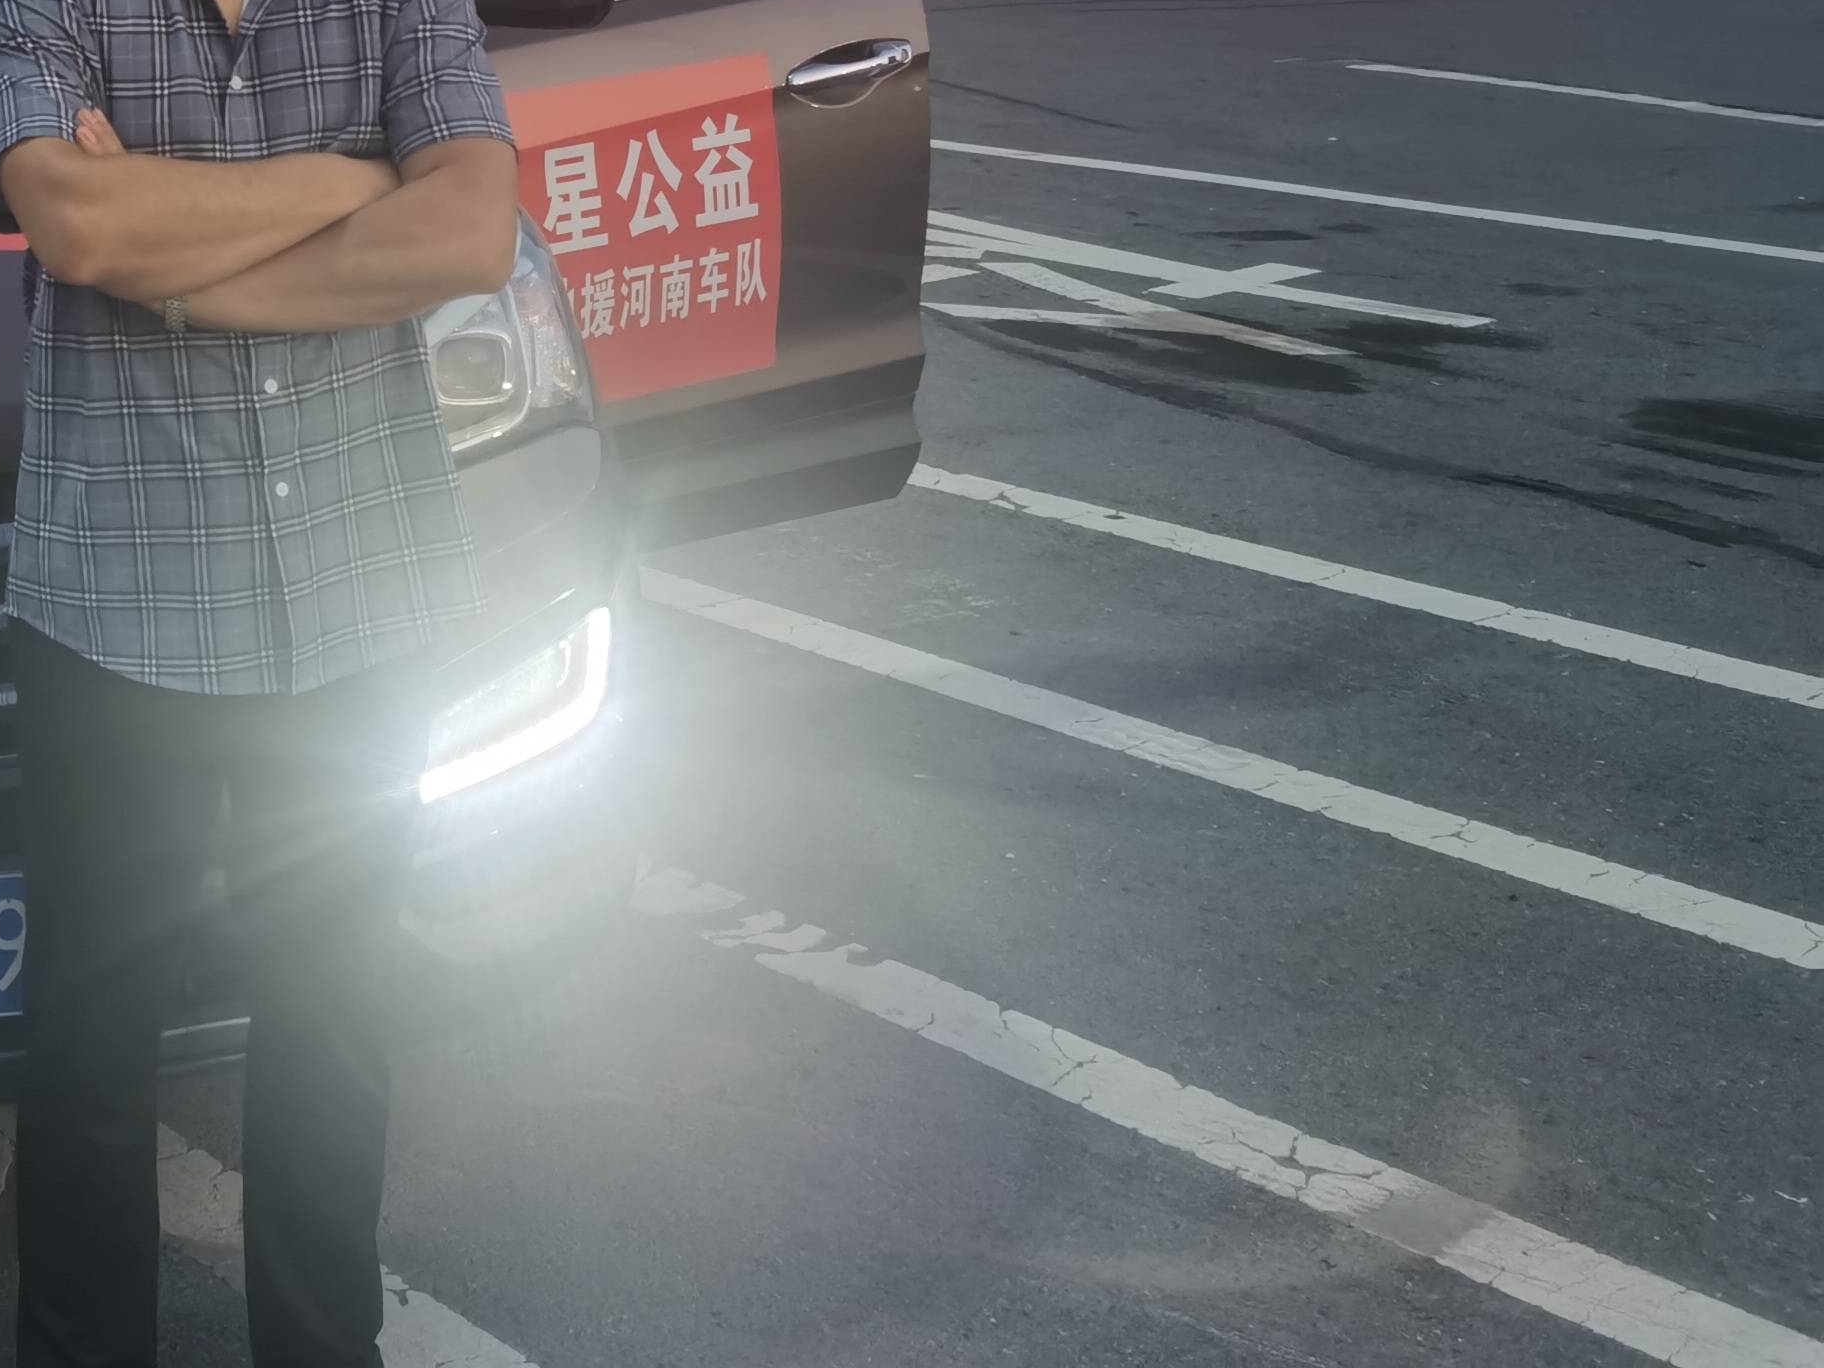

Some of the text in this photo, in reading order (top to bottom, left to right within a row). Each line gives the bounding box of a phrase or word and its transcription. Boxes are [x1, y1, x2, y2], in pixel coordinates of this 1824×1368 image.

[542, 113, 760, 256] 星公益
[562, 238, 768, 339] 援河南车队
